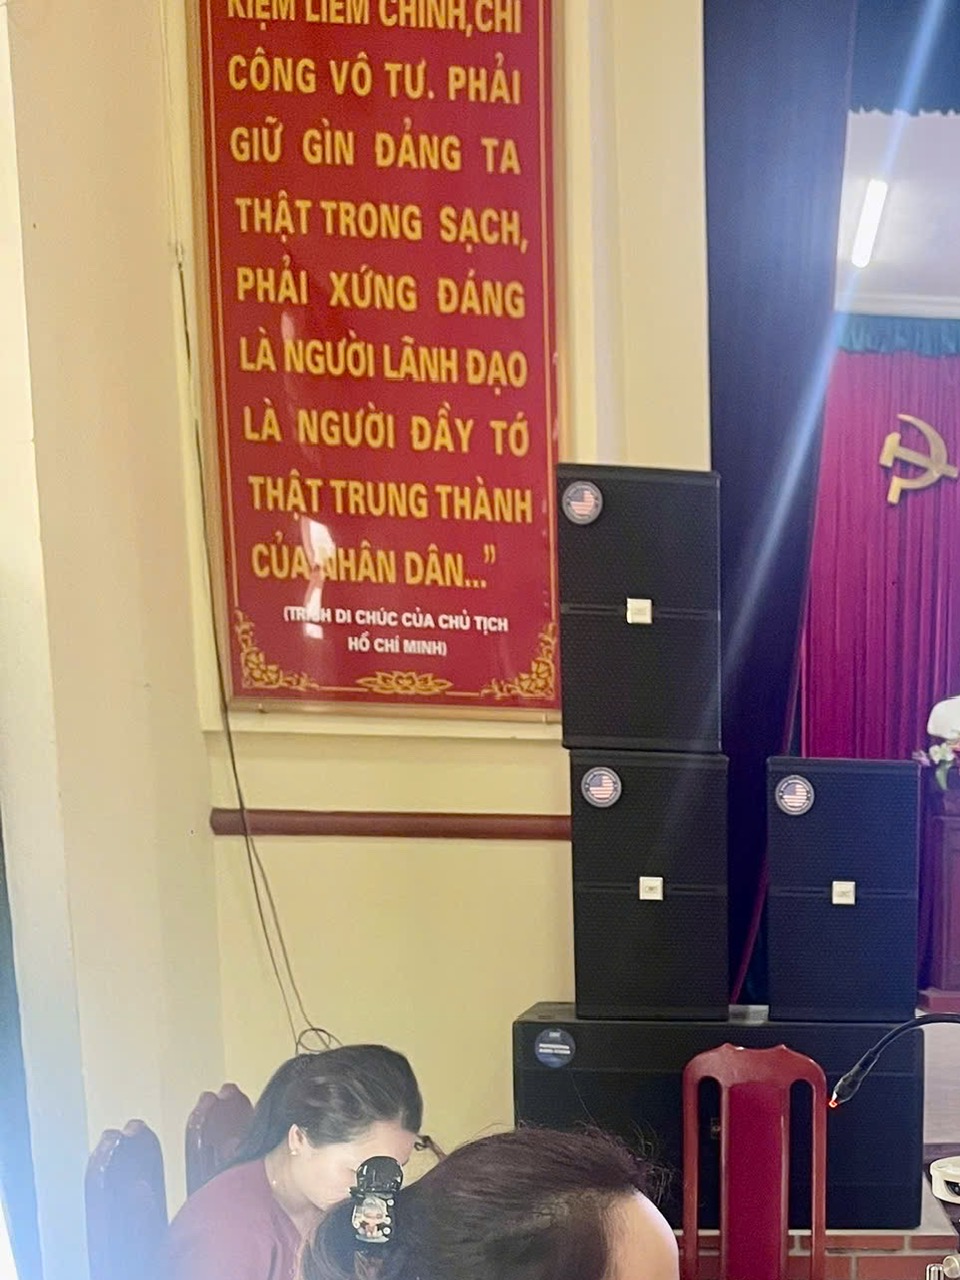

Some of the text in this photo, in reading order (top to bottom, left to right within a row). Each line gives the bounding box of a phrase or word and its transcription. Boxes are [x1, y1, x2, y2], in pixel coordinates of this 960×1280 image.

[228, 46, 521, 105] CÔNG VÔ TƯ. PHẢI
[230, 115, 521, 175] GIỮ GÌN ĐẢNG TA
[234, 189, 528, 254] THẬT TRONG SẠCH,
[236, 254, 526, 319] PHẢI XỨNG ĐÁNG
[239, 326, 528, 396] LÀ NGƯỜI LÃNH ĐẠO
[243, 397, 530, 458] LÀ NGƯỜI ĐẦY TỚ
[248, 468, 323, 521] THẬT
[329, 479, 429, 519] TRUNG
[435, 475, 533, 524] THÀNH
[251, 531, 311, 580] CỦA
[318, 539, 397, 584] NHÂN
[283, 604, 509, 636] (TRH DI CHÚC CỦA CHỦ TỊCH
[347, 630, 448, 657] HỒ CHÍ MINH)
